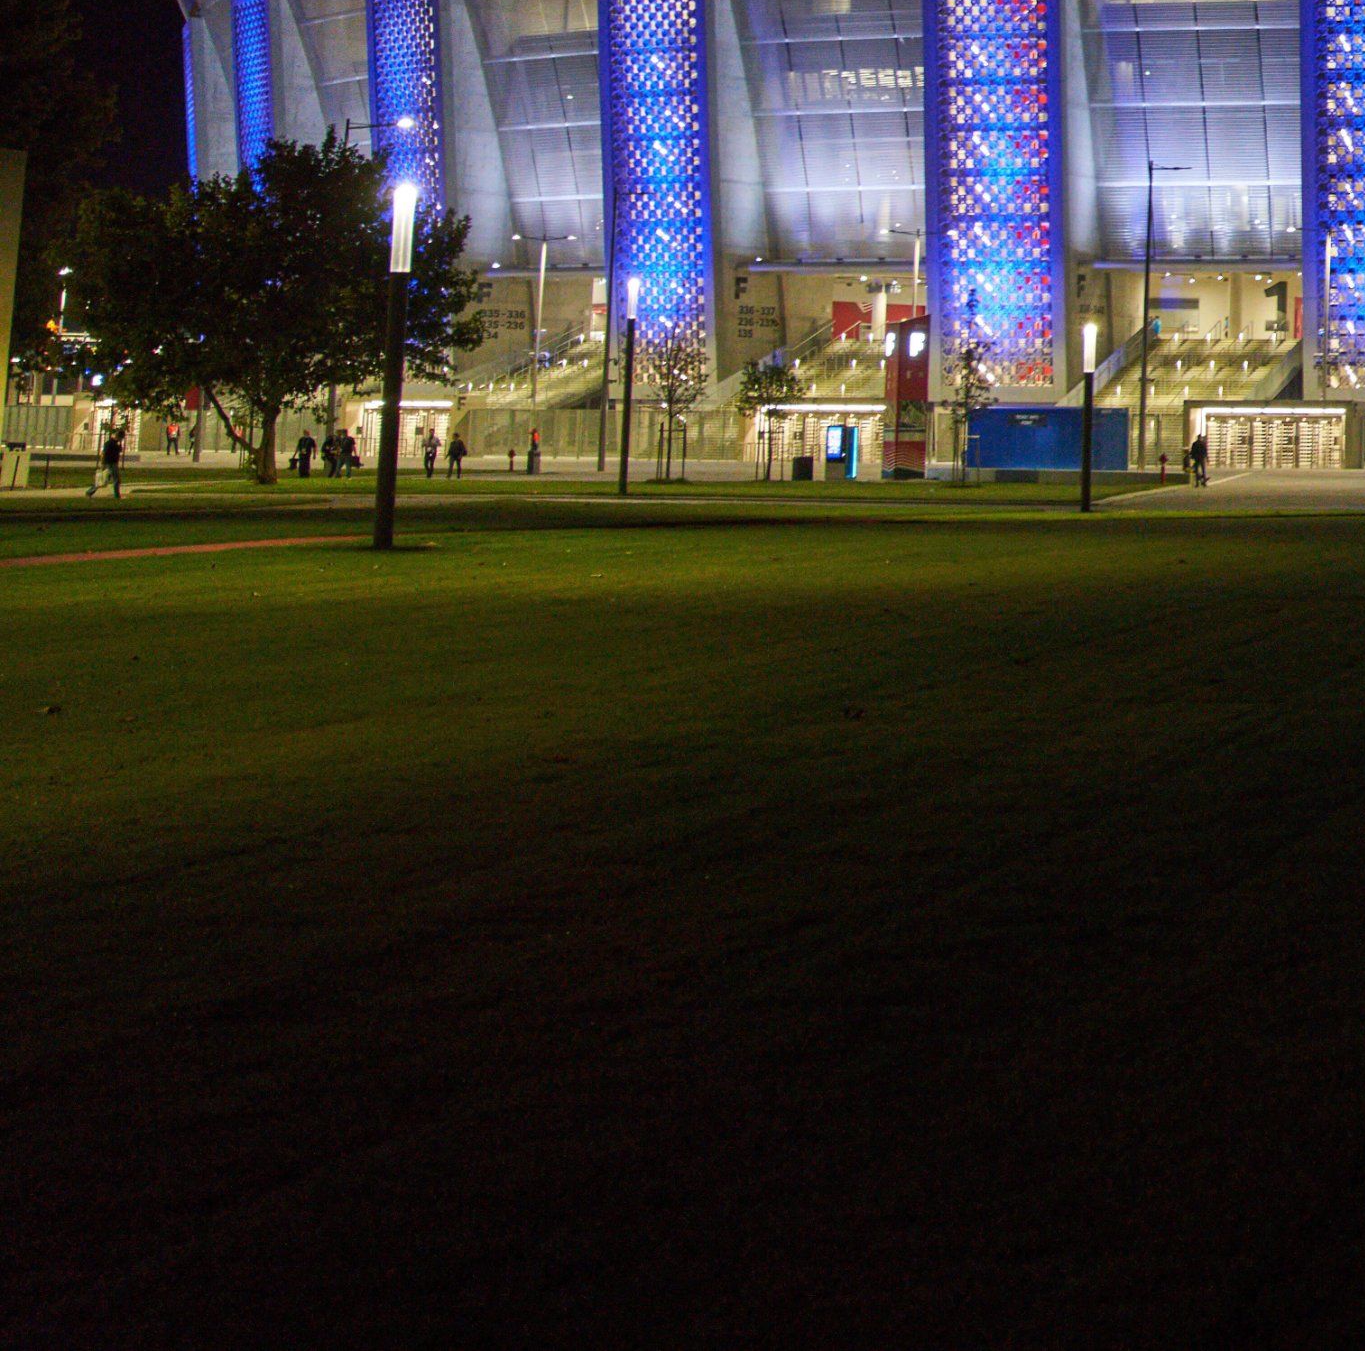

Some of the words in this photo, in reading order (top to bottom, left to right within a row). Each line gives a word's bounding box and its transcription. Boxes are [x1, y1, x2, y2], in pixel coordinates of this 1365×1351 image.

[478, 282, 493, 304] F
[735, 276, 748, 300] F
[1077, 274, 1086, 298] F
[1264, 281, 1289, 332] 1
[909, 332, 926, 358] F
[457, 396, 467, 410] F
